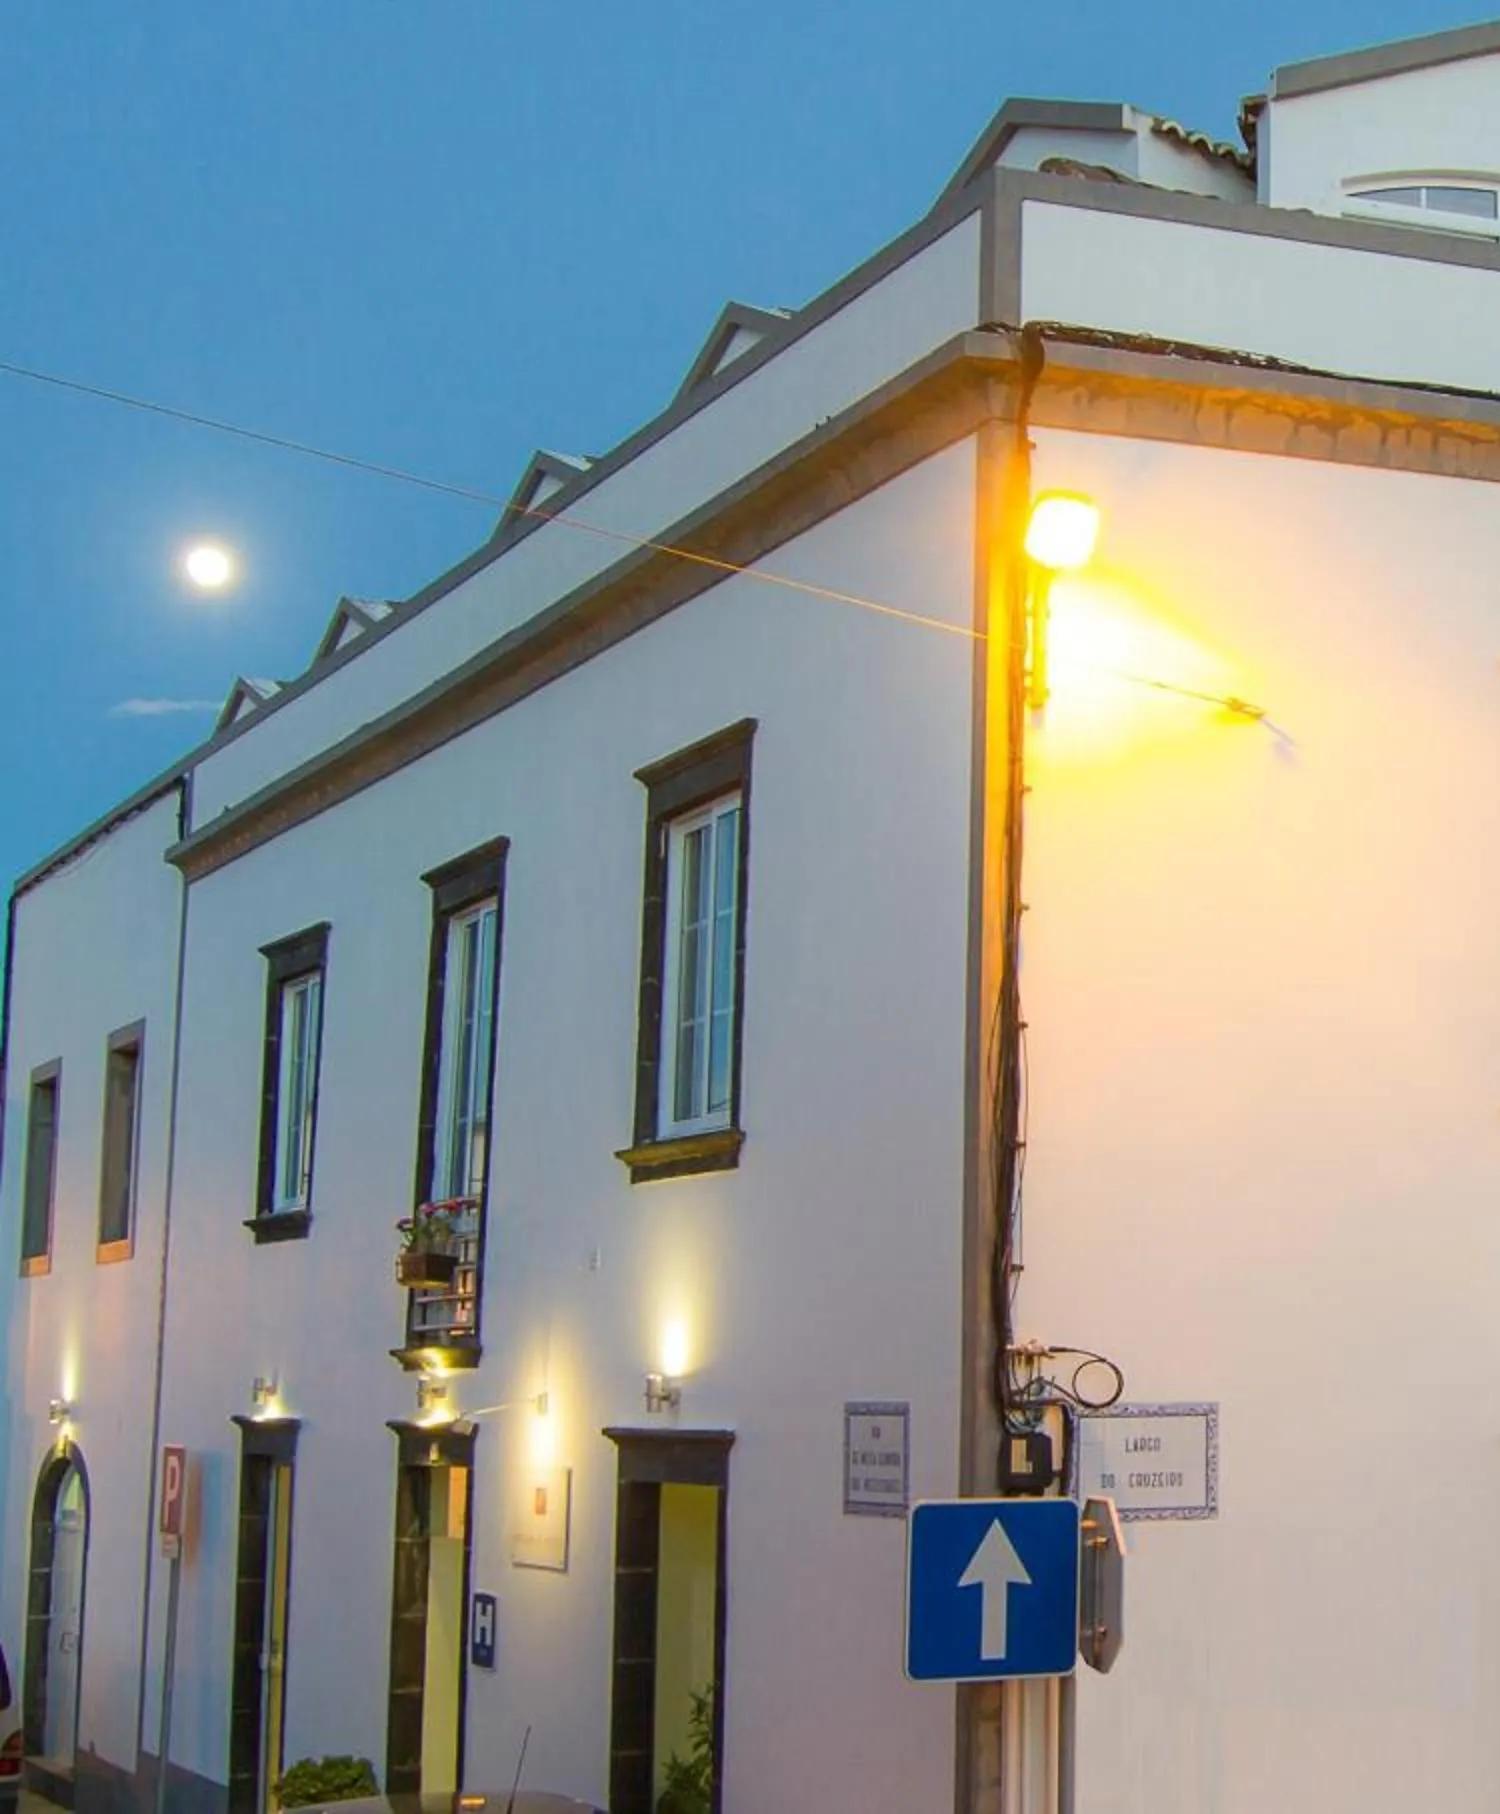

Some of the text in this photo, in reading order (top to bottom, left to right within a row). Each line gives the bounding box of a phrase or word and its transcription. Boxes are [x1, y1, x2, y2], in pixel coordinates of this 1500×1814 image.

[1124, 1436, 1162, 1453] LARGO
[163, 1455, 181, 1528] P
[474, 1600, 494, 1646] H
